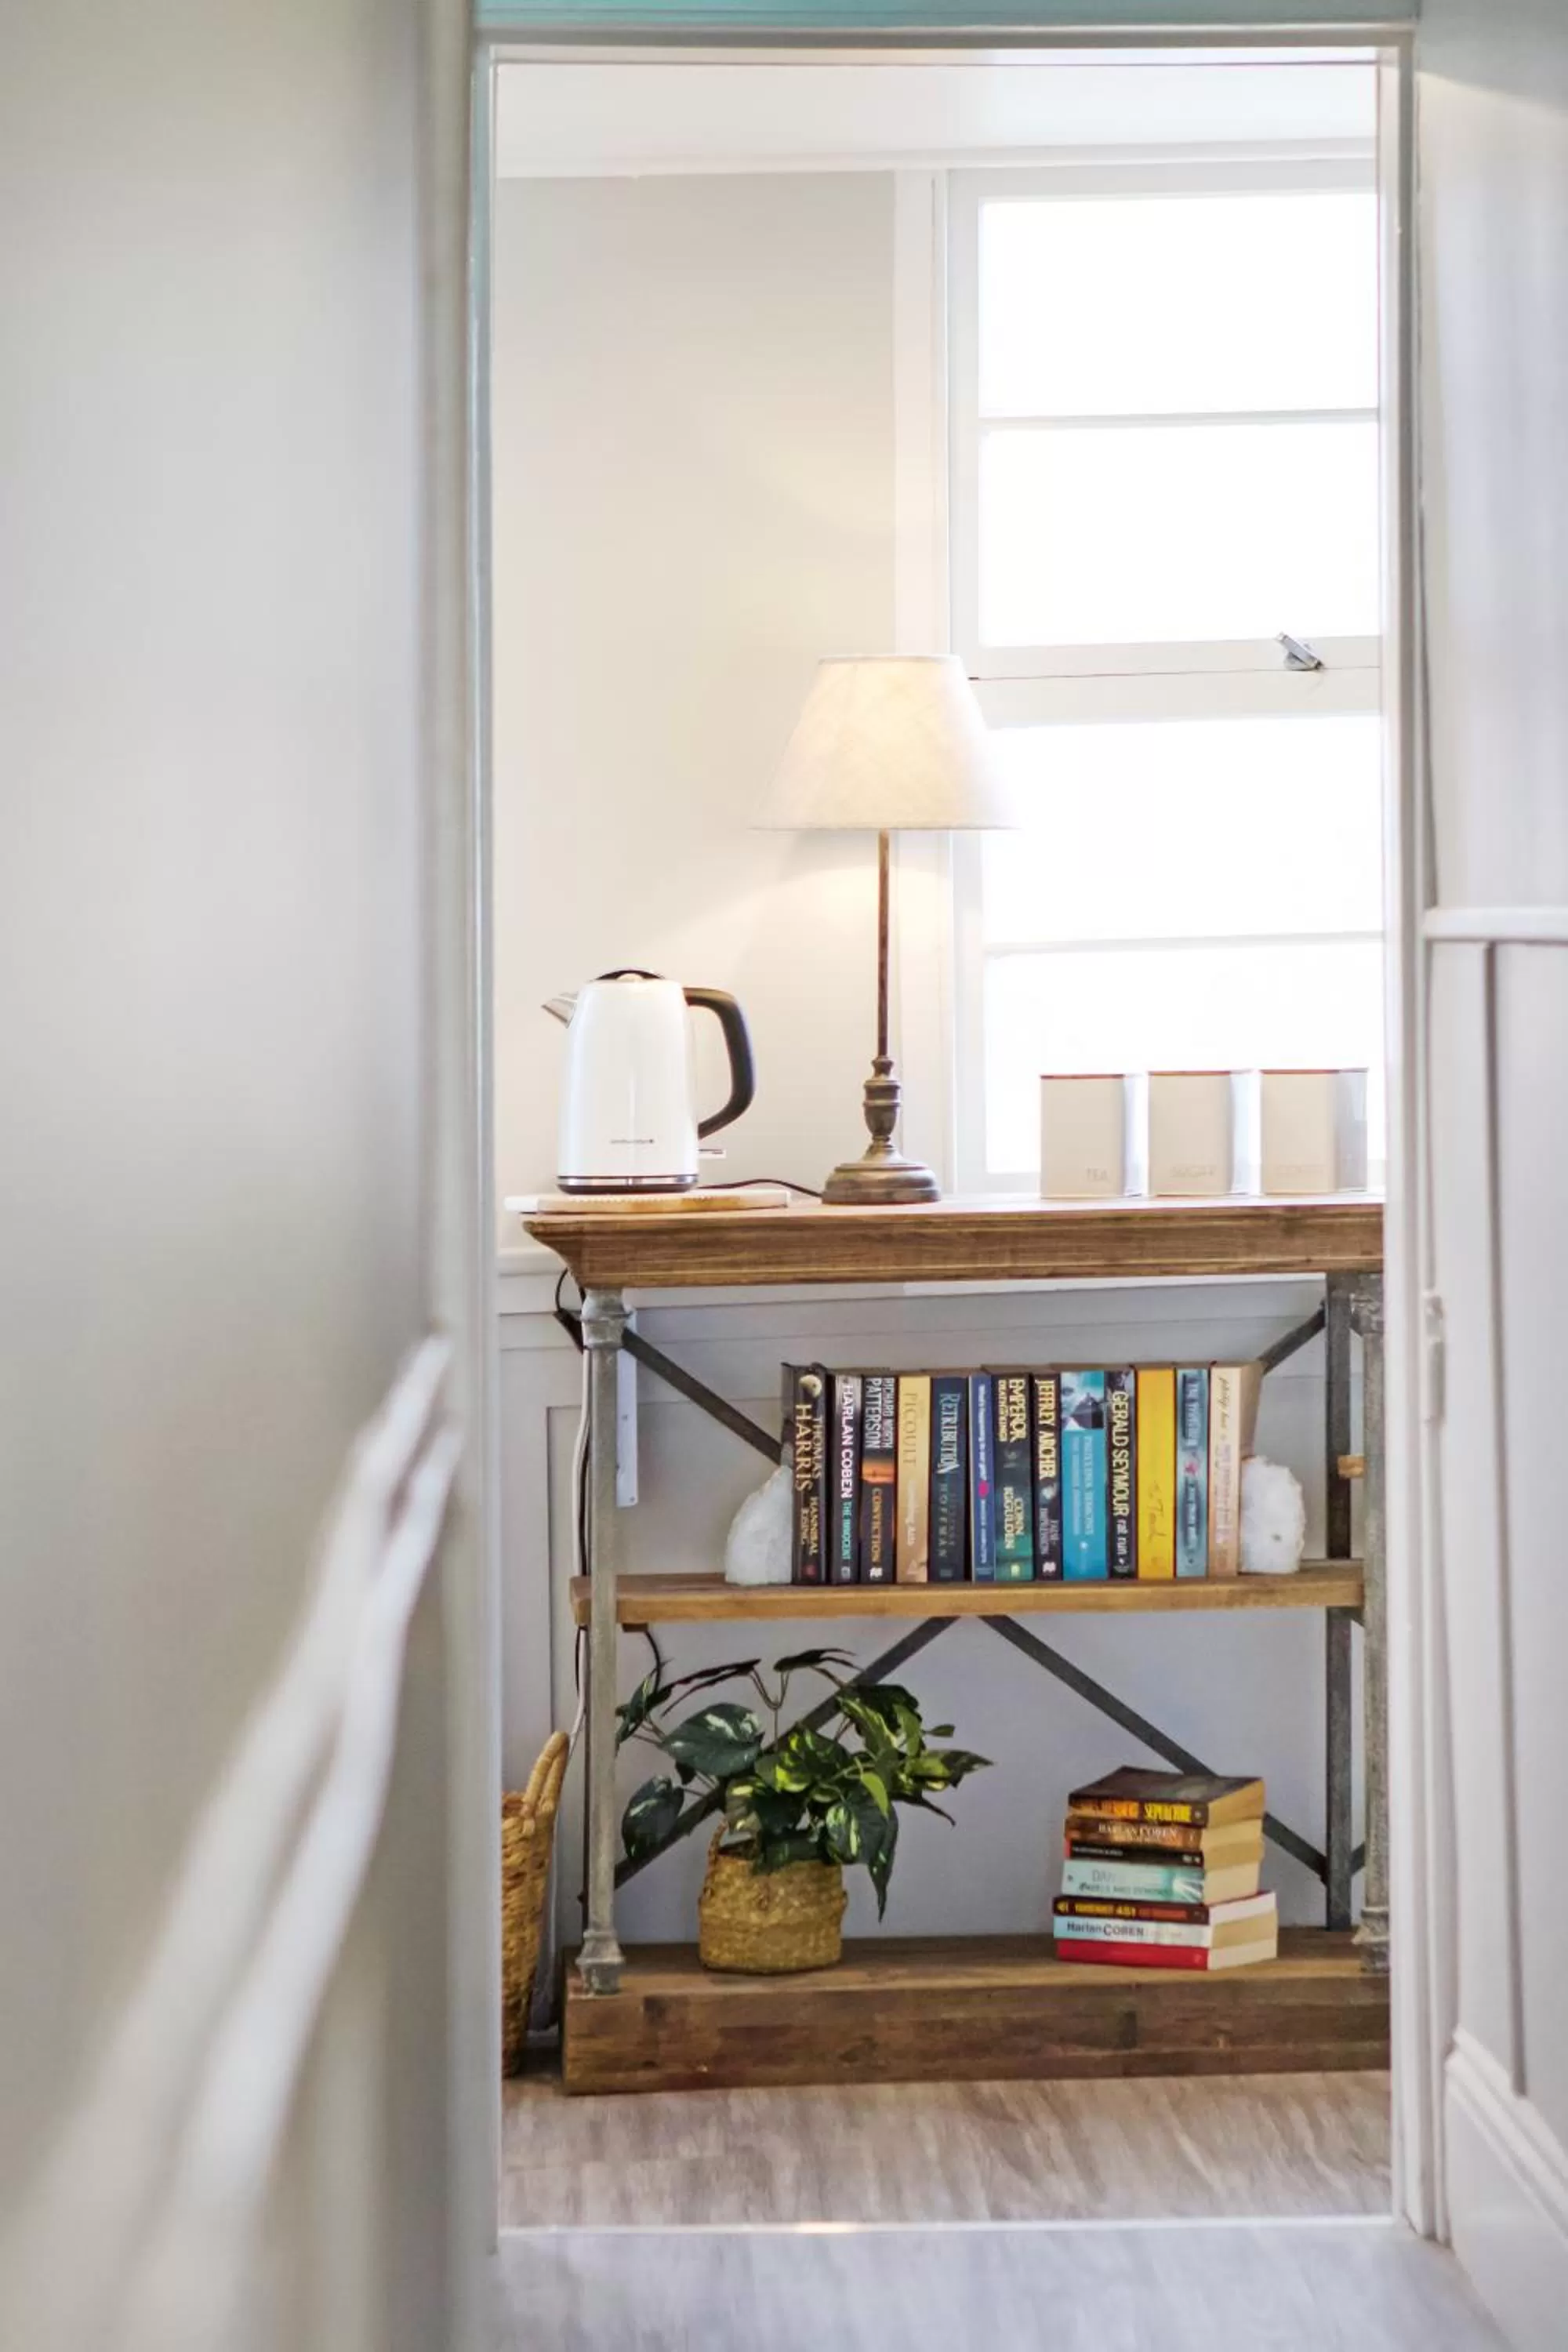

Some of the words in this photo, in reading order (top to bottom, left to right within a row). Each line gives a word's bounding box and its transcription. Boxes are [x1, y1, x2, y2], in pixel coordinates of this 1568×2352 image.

[840, 1384, 854, 1446] HARLAN
[865, 1377, 882, 1450] PATTERSON
[882, 1377, 895, 1417] RICHARD
[1009, 1378, 1027, 1443] EMPEROR
[1035, 1379, 1057, 1427] JEFFREY
[1112, 1390, 1129, 1446] GERALD
[794, 1403, 812, 1492] HARRIS
[812, 1416, 823, 1479] THOMAS
[882, 1418, 895, 1449] NORTH
[903, 1392, 919, 1468] PICOULT
[936, 1392, 961, 1474] RETRIBUTION
[1038, 1431, 1057, 1479] ARCHER
[840, 1448, 854, 1498] COBEN
[1112, 1448, 1130, 1516] SEYMOUR
[808, 1496, 819, 1556] HANNIBAL
[841, 1501, 852, 1517] THE
[870, 1487, 883, 1563] CONVICTION
[1116, 1519, 1127, 1534] rat
[841, 1519, 852, 1559] INNOCENT
[1116, 1537, 1127, 1555] run
[1066, 1921, 1101, 1933] Harlan
[1103, 1923, 1145, 1936] COBEN
